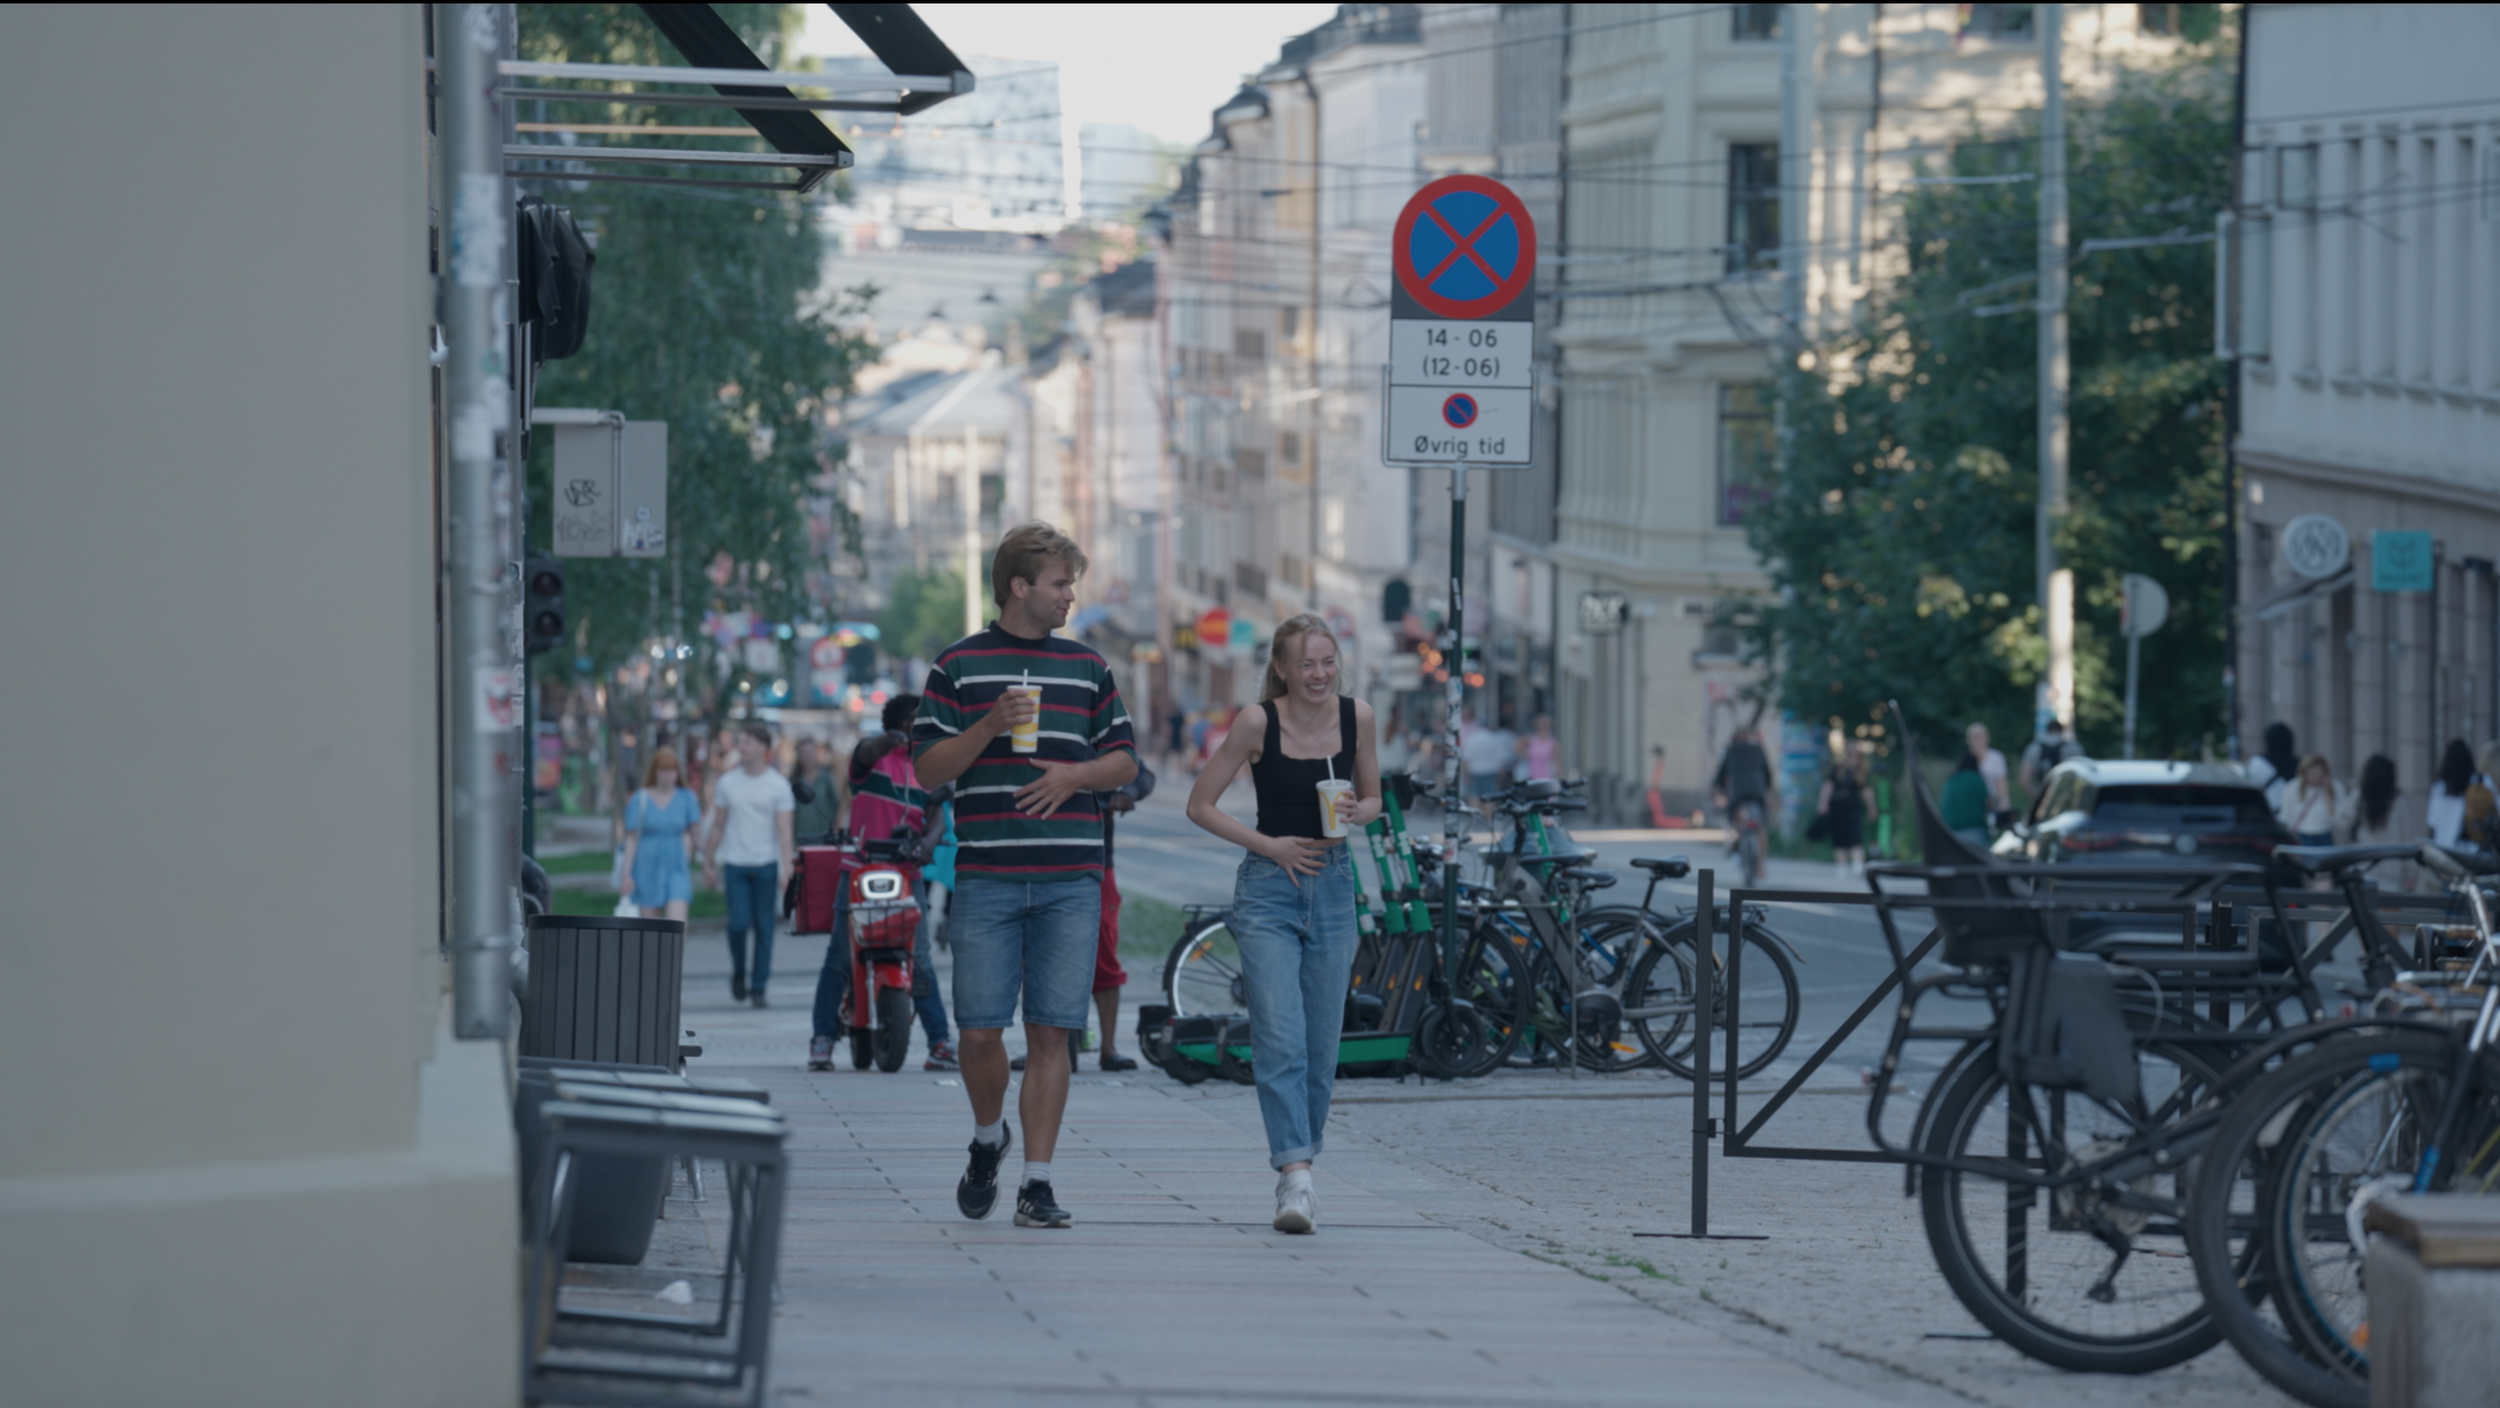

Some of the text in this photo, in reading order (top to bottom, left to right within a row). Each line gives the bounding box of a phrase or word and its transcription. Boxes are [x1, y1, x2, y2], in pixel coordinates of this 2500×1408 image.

[1426, 328, 1448, 347] 14
[1468, 328, 1498, 348] 06
[1422, 354, 1501, 379] (12-06)
[1414, 434, 1506, 459] Øvrig tid
